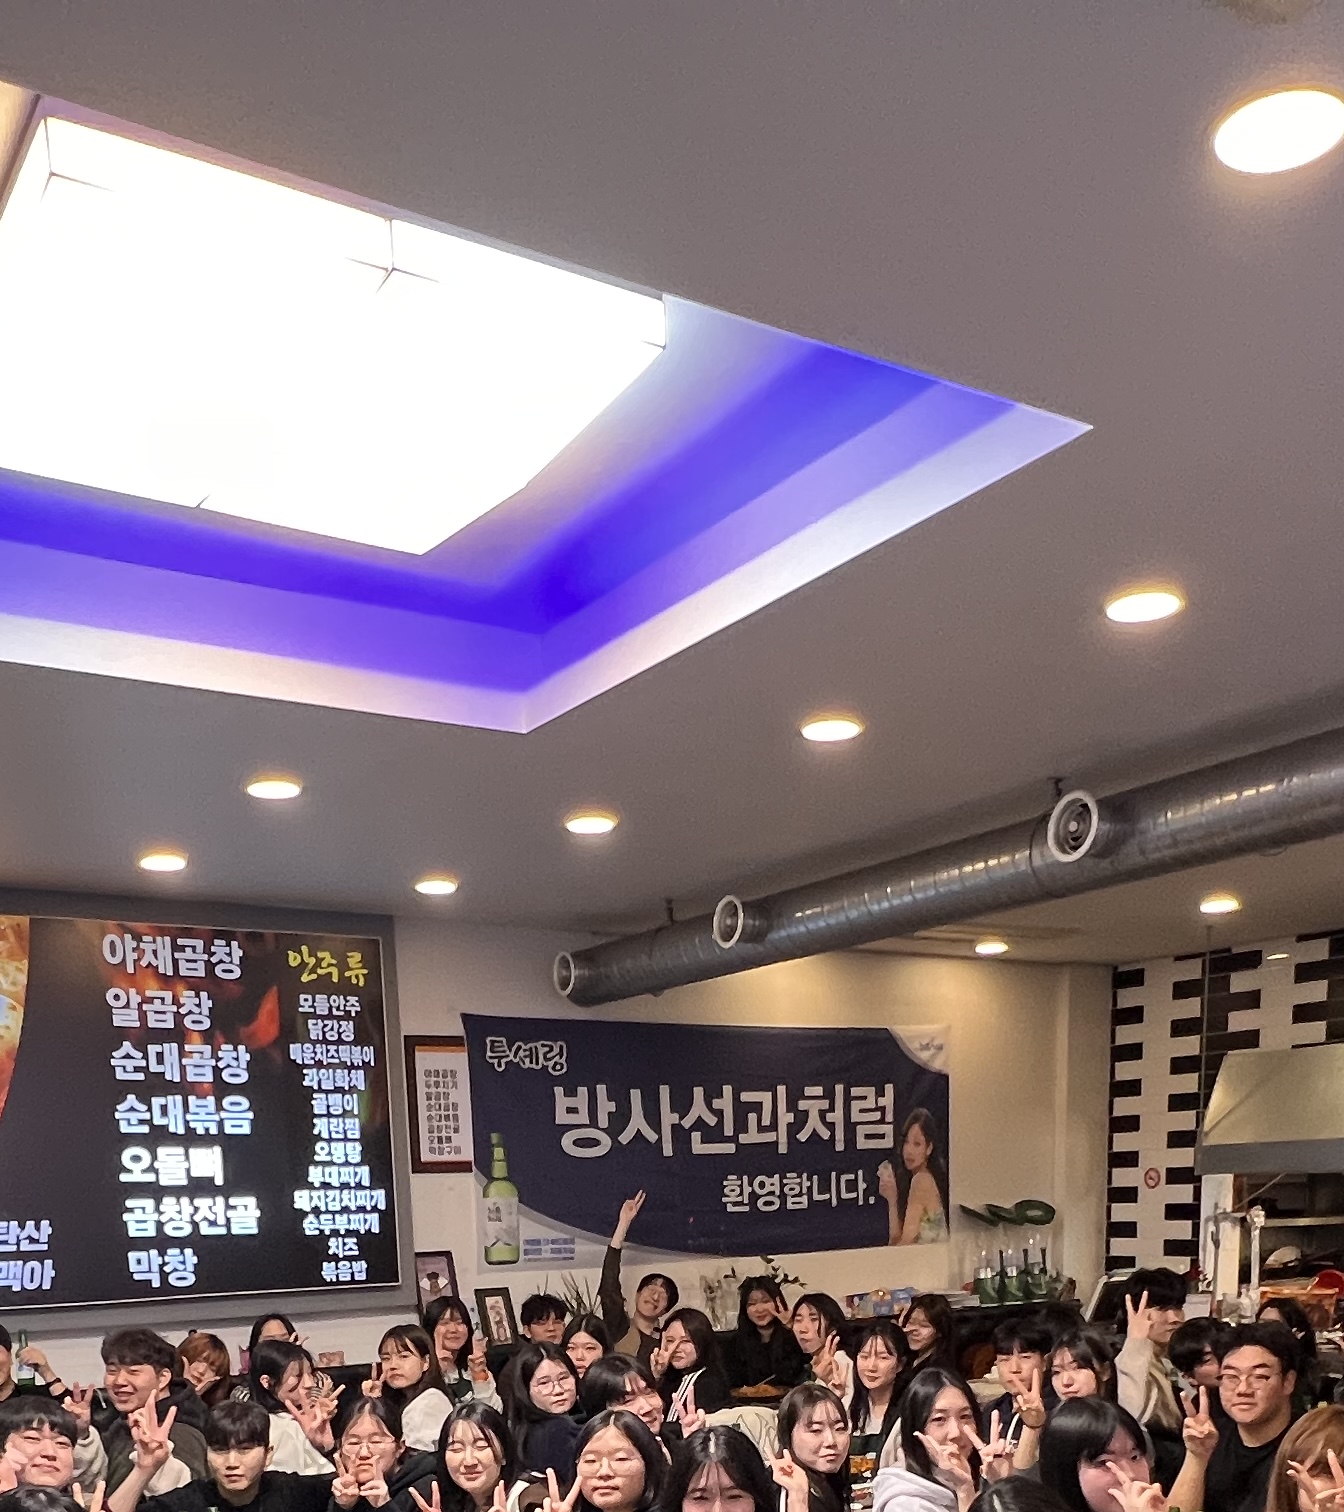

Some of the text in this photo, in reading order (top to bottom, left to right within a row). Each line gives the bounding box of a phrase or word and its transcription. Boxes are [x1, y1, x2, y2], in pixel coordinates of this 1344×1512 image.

[102, 933, 244, 980] 야채곱창
[287, 945, 369, 987] 안주류
[105, 987, 213, 1031] 알곱창
[307, 1019, 356, 1042] 닭강정
[110, 1040, 251, 1084] 순대곱창
[288, 1043, 376, 1067] 매운치즈떡볶이
[302, 1069, 366, 1091] 과일화채
[114, 1094, 255, 1135] 순대볶음
[311, 1092, 359, 1115] 골뱅이
[311, 1117, 361, 1140] 계란찜
[552, 1082, 896, 1159] 방사선과처럼
[118, 1145, 225, 1187] 오돌뼈
[307, 1165, 372, 1188] 부대찌개
[293, 1188, 387, 1213] 돼지김치찌개
[721, 1169, 876, 1213] 환영합니다.
[122, 1195, 261, 1238] 곱창전골
[302, 1213, 380, 1236] 순두부찌개
[327, 1237, 360, 1259] 치즈
[127, 1247, 199, 1288] 막창
[321, 1260, 369, 1283] 볶음밥
